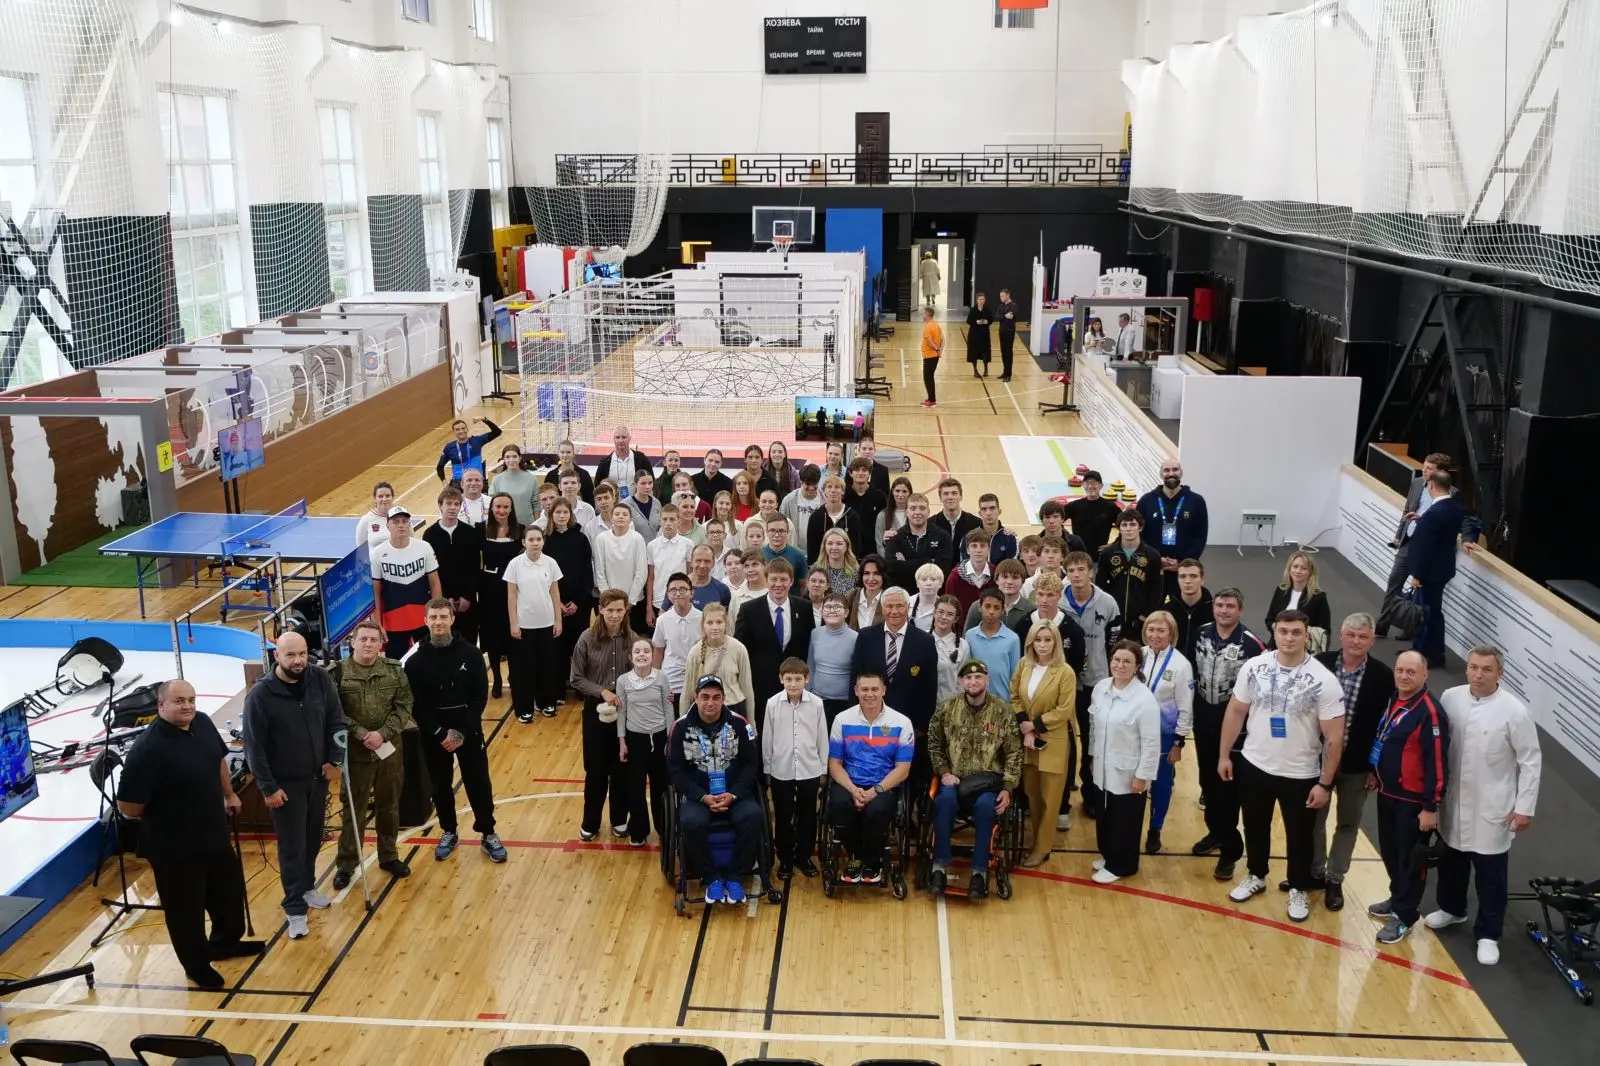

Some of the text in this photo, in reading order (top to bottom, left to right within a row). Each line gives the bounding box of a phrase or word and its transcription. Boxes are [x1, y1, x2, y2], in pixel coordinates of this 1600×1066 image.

[766, 19, 801, 27] ХОЗЯЕВА
[835, 18, 860, 26] ГОСТИ
[381, 557, 425, 578] РОССИЯ
